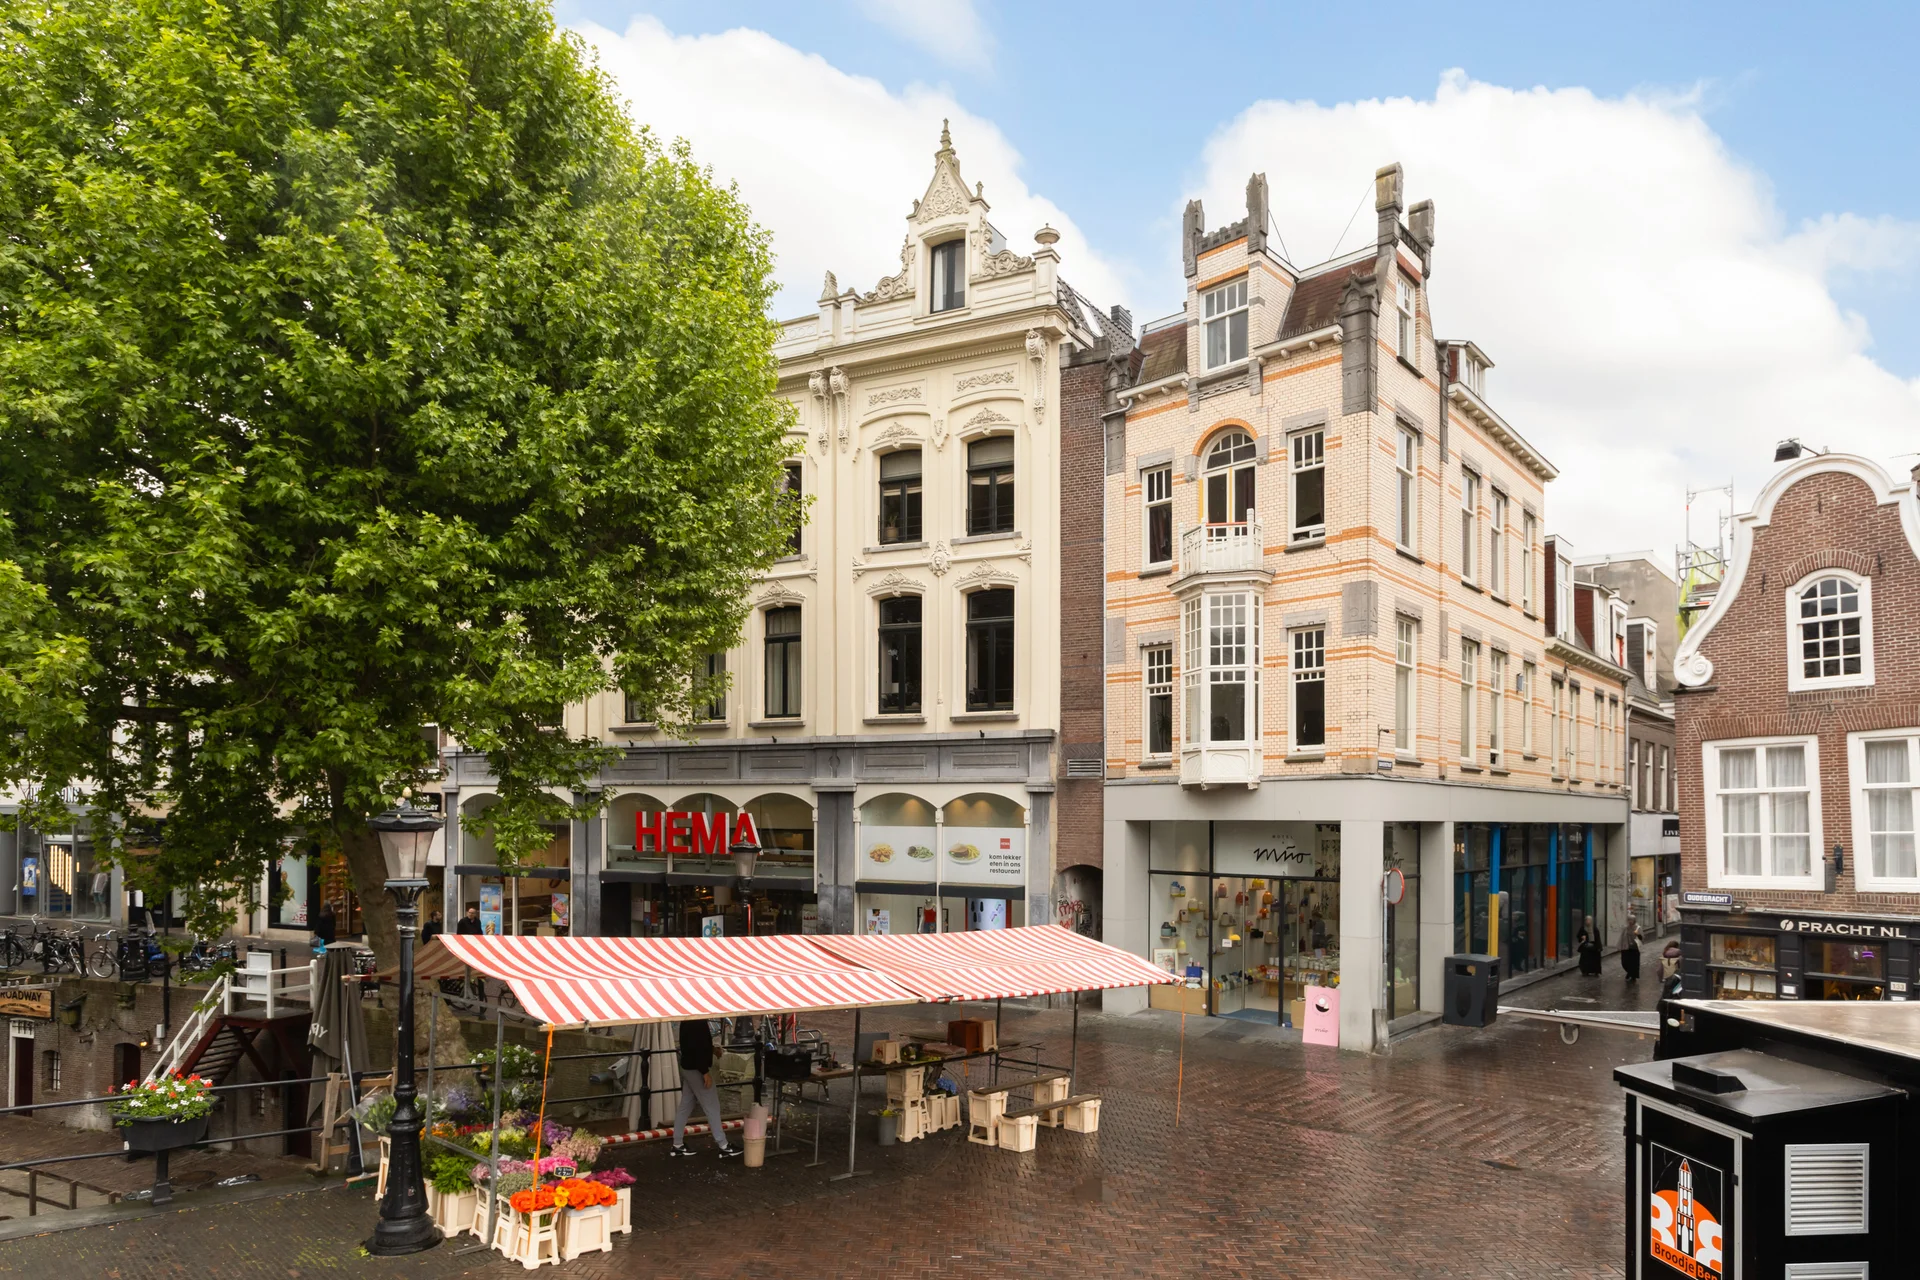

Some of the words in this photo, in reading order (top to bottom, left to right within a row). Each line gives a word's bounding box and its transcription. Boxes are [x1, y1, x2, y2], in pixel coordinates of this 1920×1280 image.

[635, 811, 764, 855] HEMA
[1687, 894, 1728, 903] OUDEGRACHT
[1654, 1242, 1695, 1273] Broodje
